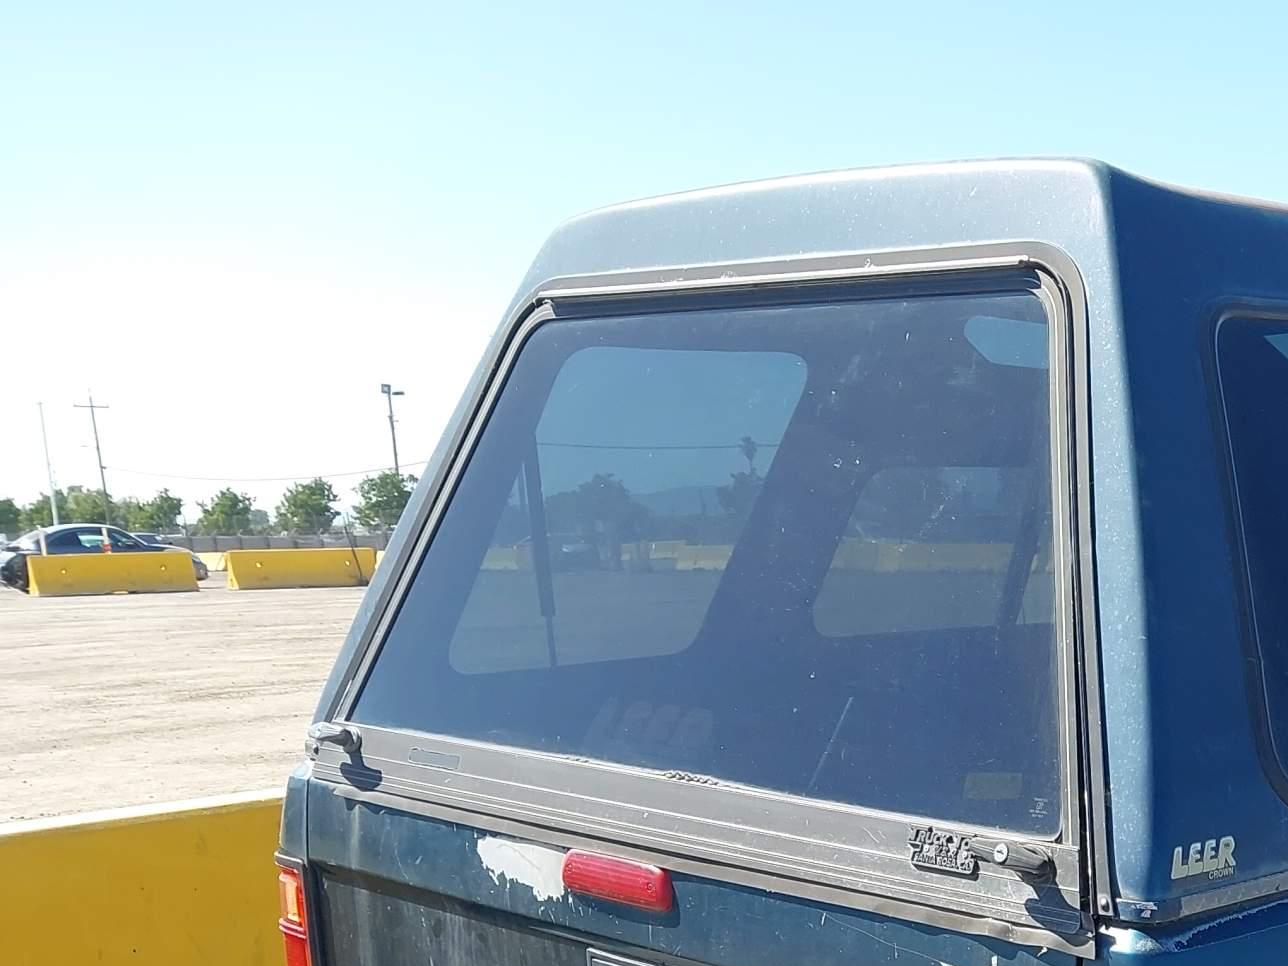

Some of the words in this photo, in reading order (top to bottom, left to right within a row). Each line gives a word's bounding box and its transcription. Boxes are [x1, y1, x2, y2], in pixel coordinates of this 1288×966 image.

[908, 827, 947, 846] TRUCK
[914, 851, 935, 865] SANTA
[1171, 835, 1237, 880] LEER
[1209, 866, 1235, 880] CROWN
